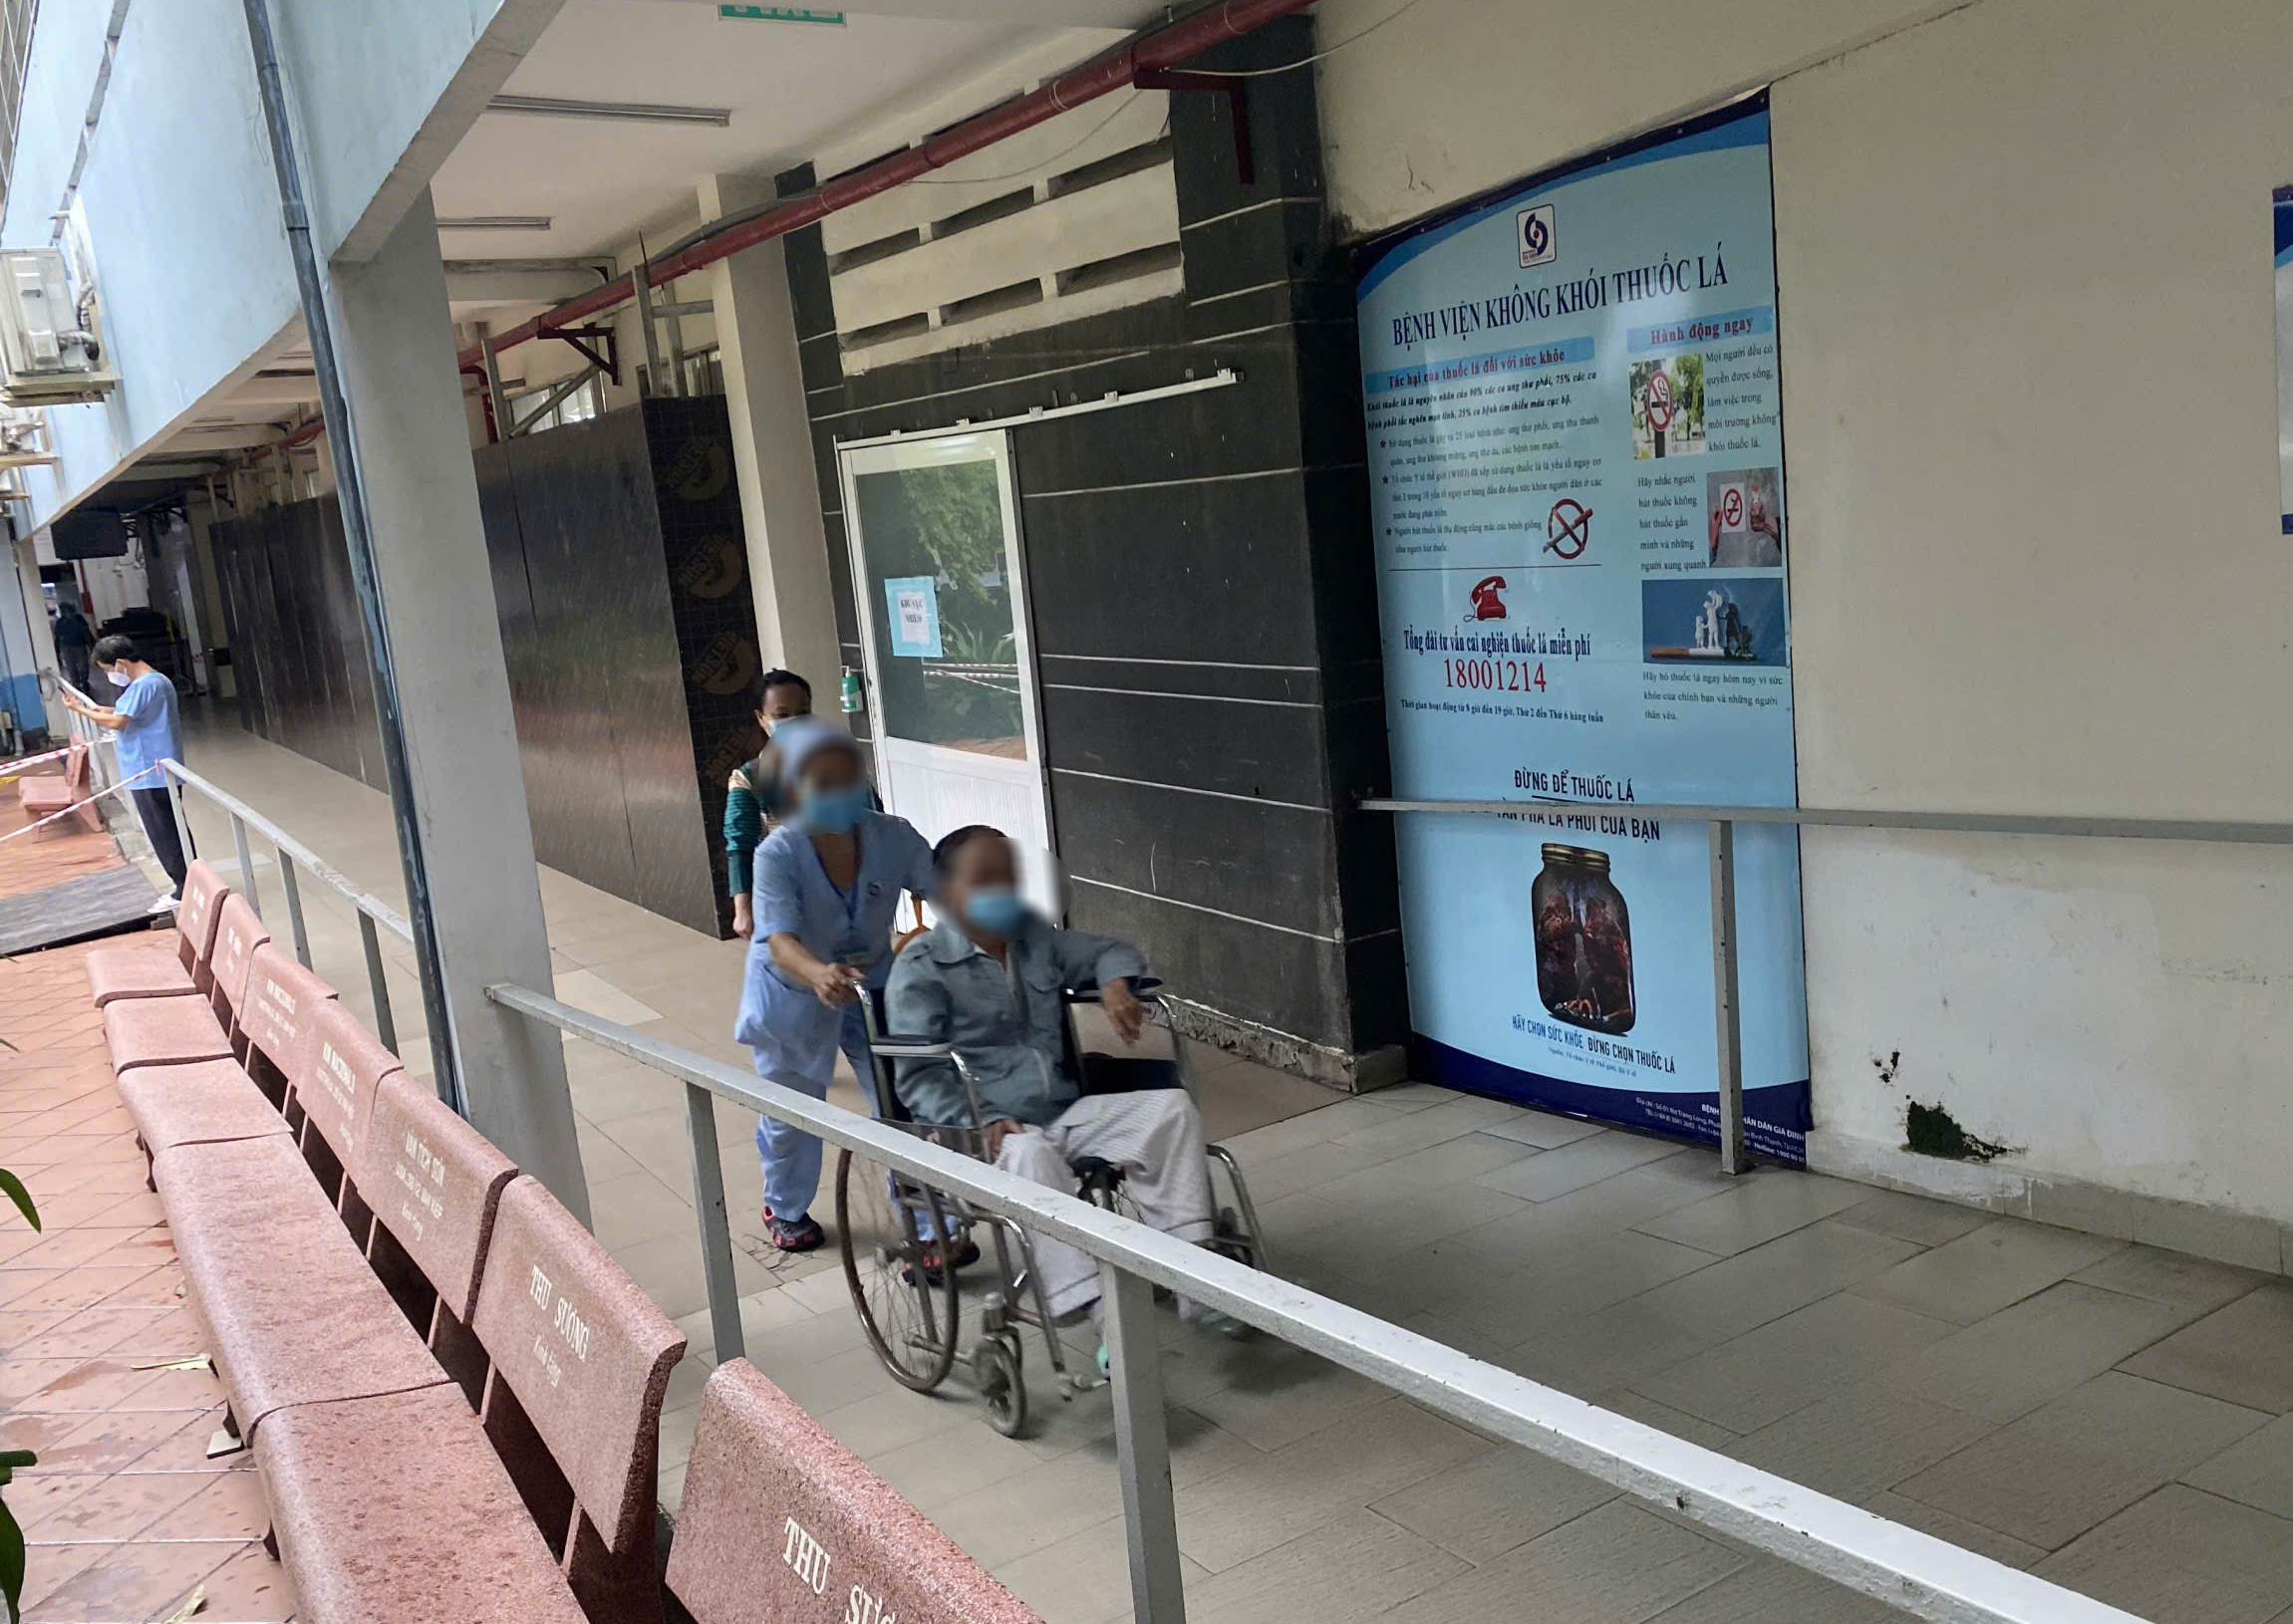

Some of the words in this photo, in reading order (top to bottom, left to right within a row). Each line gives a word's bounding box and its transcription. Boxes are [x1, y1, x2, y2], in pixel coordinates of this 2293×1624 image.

[1392, 311, 1436, 350] BỆNH
[1441, 300, 1481, 342] VIỆN
[1486, 284, 1552, 329] KHÔNG
[1555, 267, 1607, 315] KHÓI
[1612, 253, 1690, 304] THUỐC
[1698, 241, 1728, 290] LÁ
[1650, 326, 1684, 345] Hành
[1689, 323, 1720, 341] động
[1724, 317, 1754, 335] ngay
[1705, 352, 1721, 364] Mọi
[1723, 347, 1745, 362] người
[1747, 344, 1762, 356] đều
[1763, 344, 1773, 355] có
[1388, 374, 1404, 388] Tác
[1407, 372, 1421, 388] hại
[1442, 362, 1468, 379] thuốc
[1471, 362, 1480, 375] lá
[1483, 355, 1498, 373] đối
[1502, 356, 1516, 370] với
[1520, 353, 1537, 368] sức
[1540, 349, 1565, 365] khỏe
[1556, 374, 1571, 385] 75%
[1706, 370, 1729, 387] quyền
[1731, 371, 1750, 385] được
[1723, 394, 1739, 406] việc
[1741, 395, 1762, 406] trong
[1725, 416, 1750, 428] trường
[1752, 412, 1777, 426] không
[1709, 437, 1725, 451] khói
[1728, 435, 1749, 450] thuốc
[1674, 472, 1695, 486] người
[1652, 494, 1672, 507] thuốc
[1674, 495, 1697, 507] không
[1653, 515, 1672, 528] thuốc
[1675, 514, 1688, 529] gần
[1640, 538, 1658, 550] mình
[1660, 538, 1669, 549] và
[1671, 537, 1694, 551] những
[1641, 560, 1661, 573] người
[1663, 561, 1682, 572] xung
[1404, 625, 1424, 656] Tổng
[1425, 632, 1438, 652] đài
[1439, 635, 1447, 652] tư
[1450, 625, 1464, 653] vấn
[1467, 635, 1478, 653] cai
[1481, 630, 1510, 658] nghiện
[1512, 627, 1536, 655] thuốc
[1539, 633, 1547, 655] lá
[1550, 628, 1573, 656] miễn
[1576, 633, 1590, 662] phí
[1444, 658, 1547, 692] 18001214
[1671, 670, 1690, 681] thuốc
[1693, 672, 1700, 682] lá
[1702, 675, 1720, 685] ngay
[1722, 672, 1740, 683] hôm
[1742, 676, 1756, 686] nay
[1769, 674, 1783, 685] sức
[1728, 693, 1753, 706] những
[1755, 695, 1778, 708] người
[1515, 766, 1548, 792] ĐỪNG
[1553, 769, 1569, 795] ĐỂ
[1571, 773, 1612, 800] THUỐC
[1617, 778, 1634, 803] LÁ
[1631, 818, 1660, 844] BẠN
[1512, 1014, 1526, 1030] HÃY
[1527, 1020, 1546, 1037] CHỌN
[1548, 1024, 1564, 1043] SỨC
[1587, 1036, 1610, 1056] ĐỪNG
[1612, 1043, 1634, 1065] CHỌN
[1635, 1049, 1662, 1071] THUỐC
[1664, 1056, 1676, 1075] LÁ
[1701, 1103, 1720, 1116] BỆNH
[1757, 1120, 1773, 1132] DÂN
[1774, 1126, 1786, 1136] GIA
[529, 1263, 552, 1311] THU
[782, 1515, 831, 1595] THU
